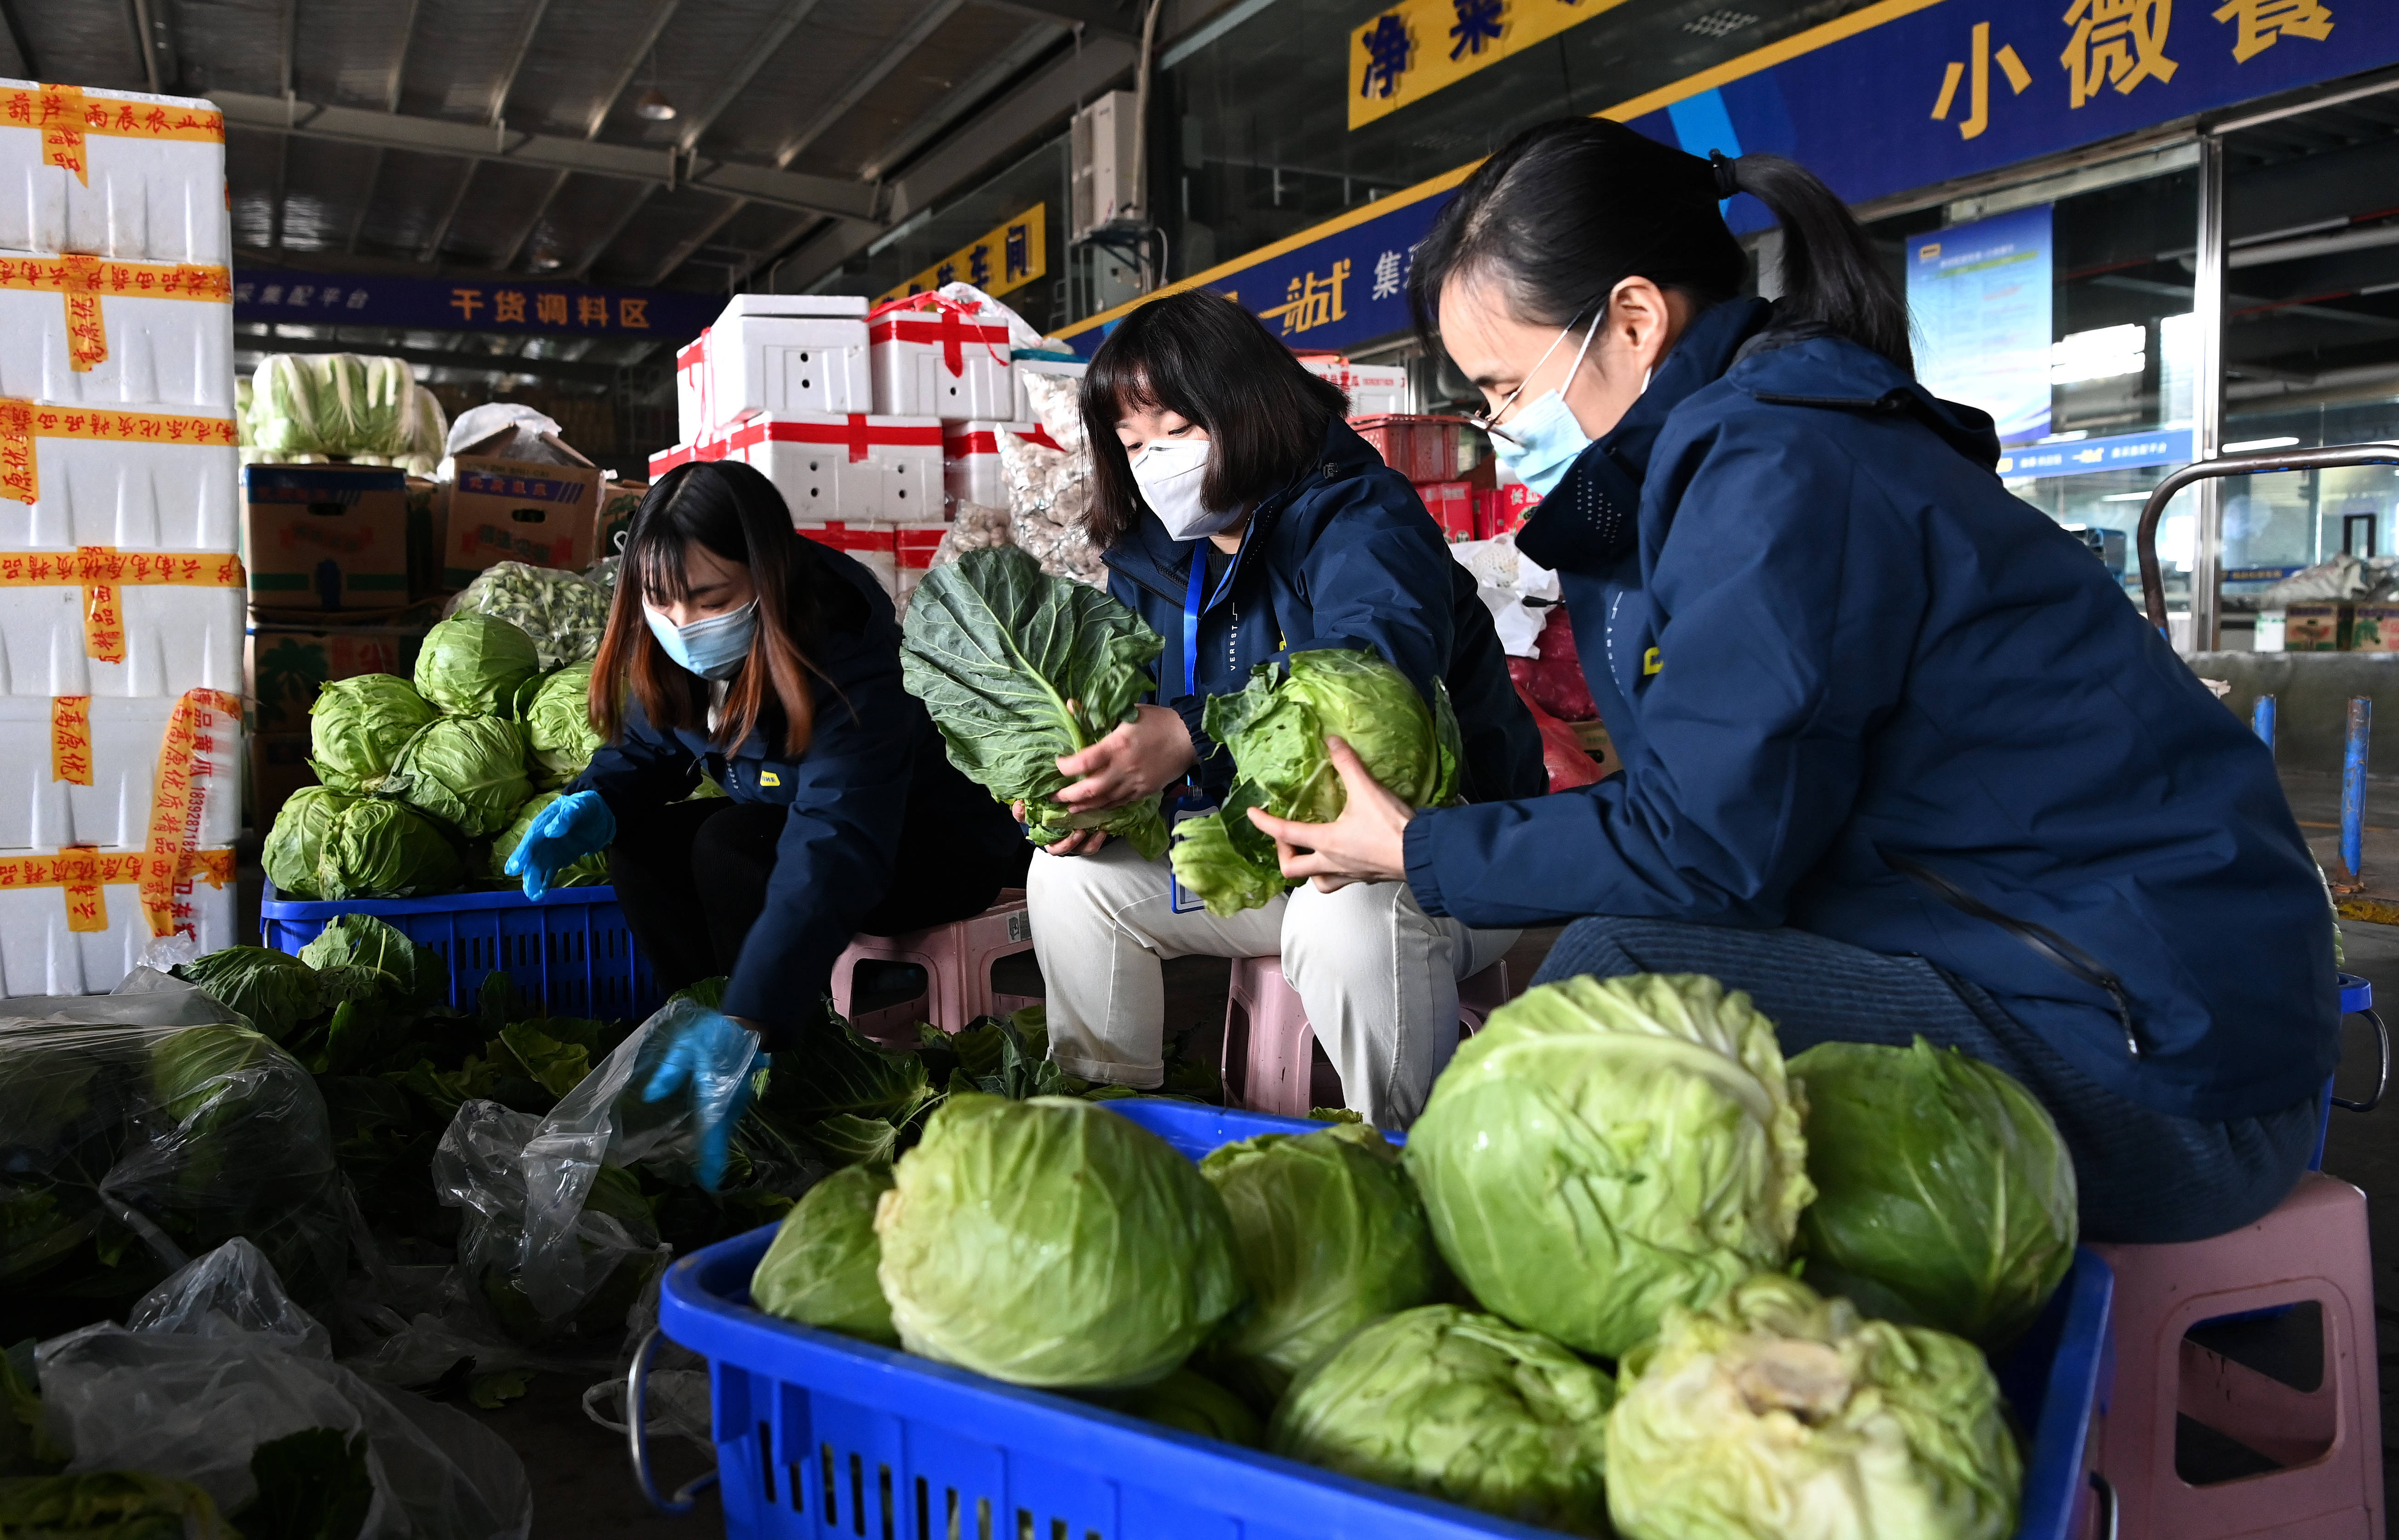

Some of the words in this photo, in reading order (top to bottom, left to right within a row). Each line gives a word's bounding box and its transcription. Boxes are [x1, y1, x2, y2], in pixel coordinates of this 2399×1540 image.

[1372, 248, 1413, 301] 集
[449, 288, 650, 329] 干货调料区
